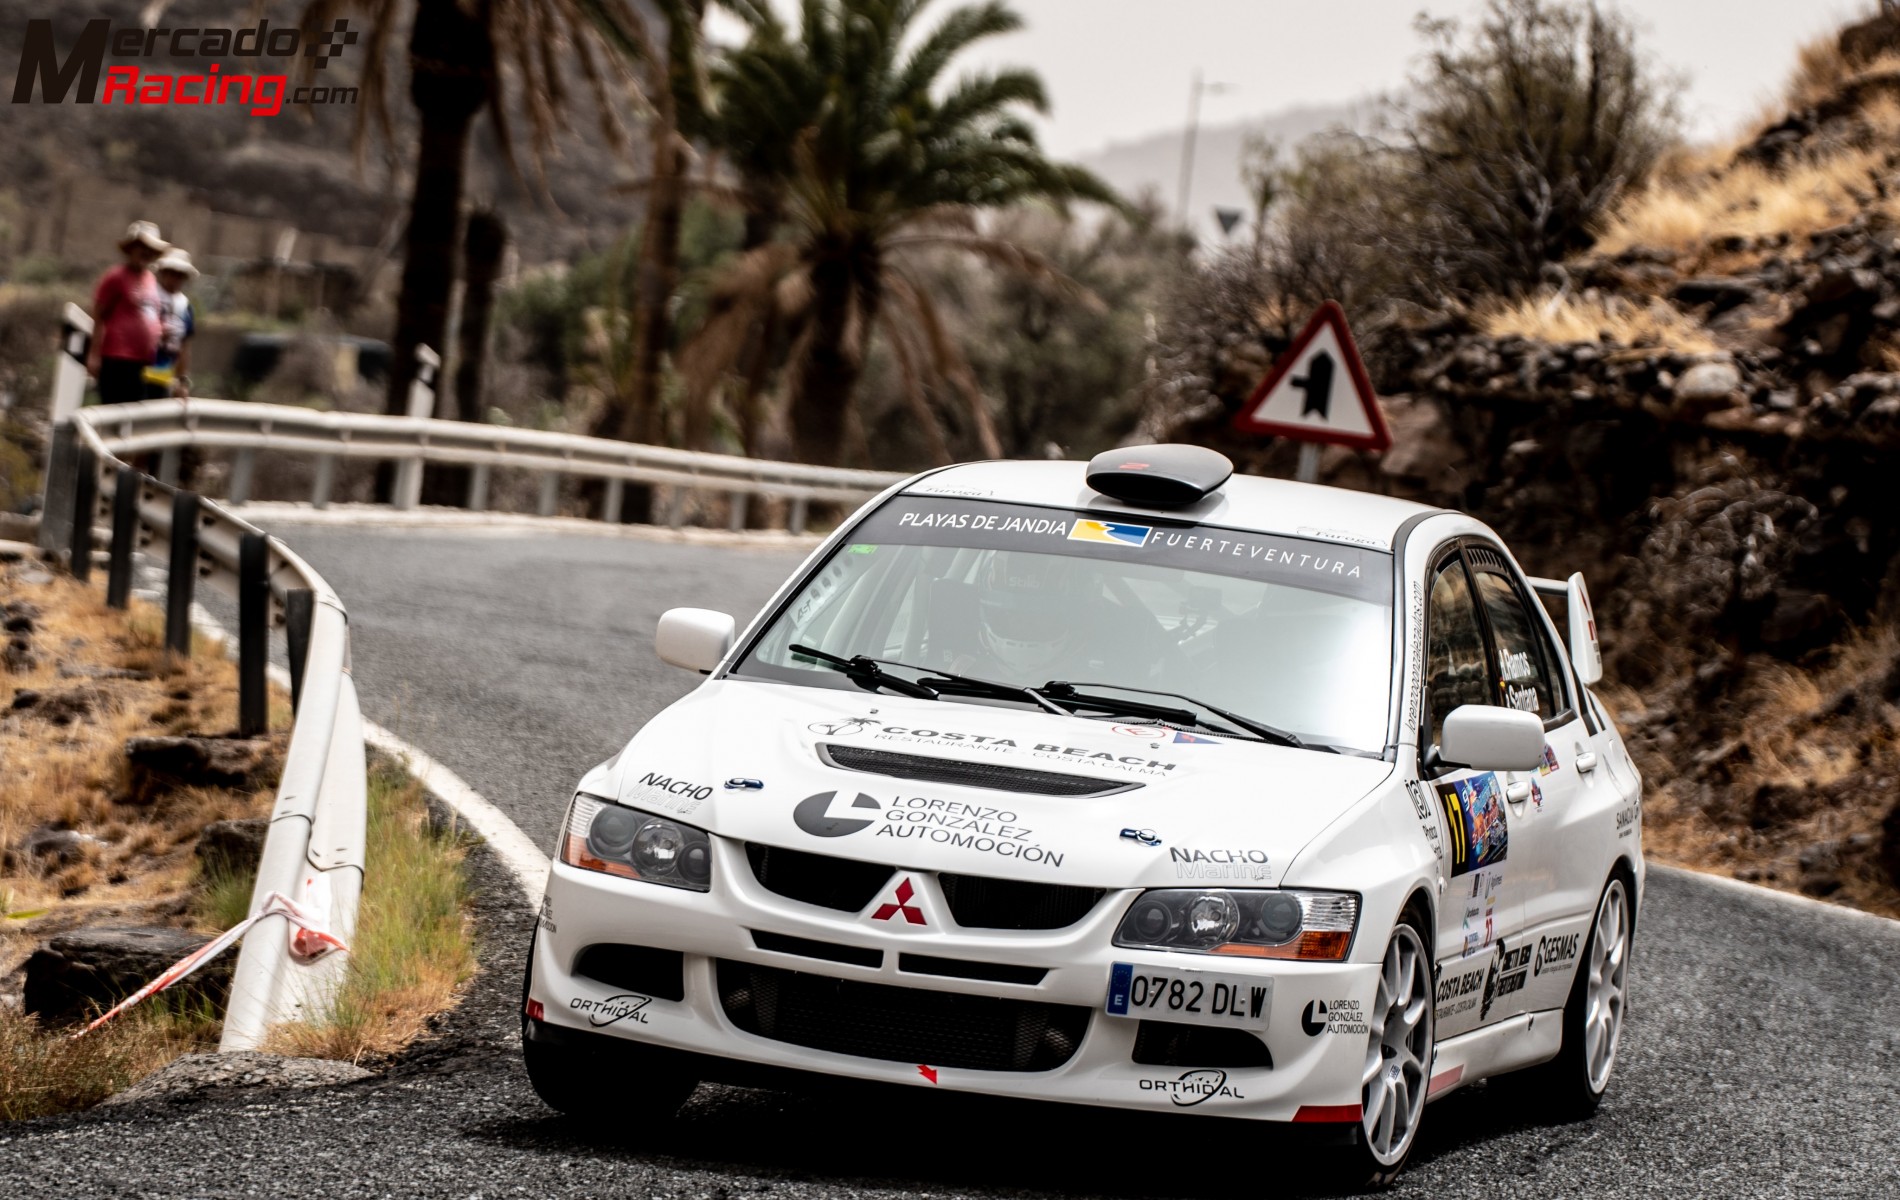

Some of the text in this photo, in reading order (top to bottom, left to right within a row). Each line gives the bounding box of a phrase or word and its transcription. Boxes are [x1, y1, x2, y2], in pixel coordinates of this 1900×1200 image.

[899, 512, 1066, 535] PLAYAS DE JANDIA
[1151, 531, 1362, 578] FUERTEVENTURA
[874, 734, 1167, 777] RESTAURANTE COSTA CALMA
[883, 726, 1177, 771] COSTA BEACH
[639, 772, 713, 800] NACHO
[892, 796, 1018, 823] LORENZO
[885, 810, 1032, 842] GONZÁLEZ
[1445, 793, 1465, 864] 17
[876, 824, 1064, 867] AUTOMOCIÓN
[1169, 847, 1268, 864] NACHO
[1176, 860, 1272, 880] Marine
[1544, 933, 1579, 962] GESMAS
[1130, 975, 1267, 1018] 0782 DLW
[1437, 973, 1460, 1003] COSTA
[1460, 968, 1485, 995] BEACH
[570, 997, 649, 1025] ORTHIDAL
[1114, 994, 1124, 1006] E
[1329, 1000, 1360, 1010] LORENZO
[1327, 1022, 1369, 1034] AUTOMOCIÓN
[1139, 1078, 1245, 1099] ORTHIDAL
